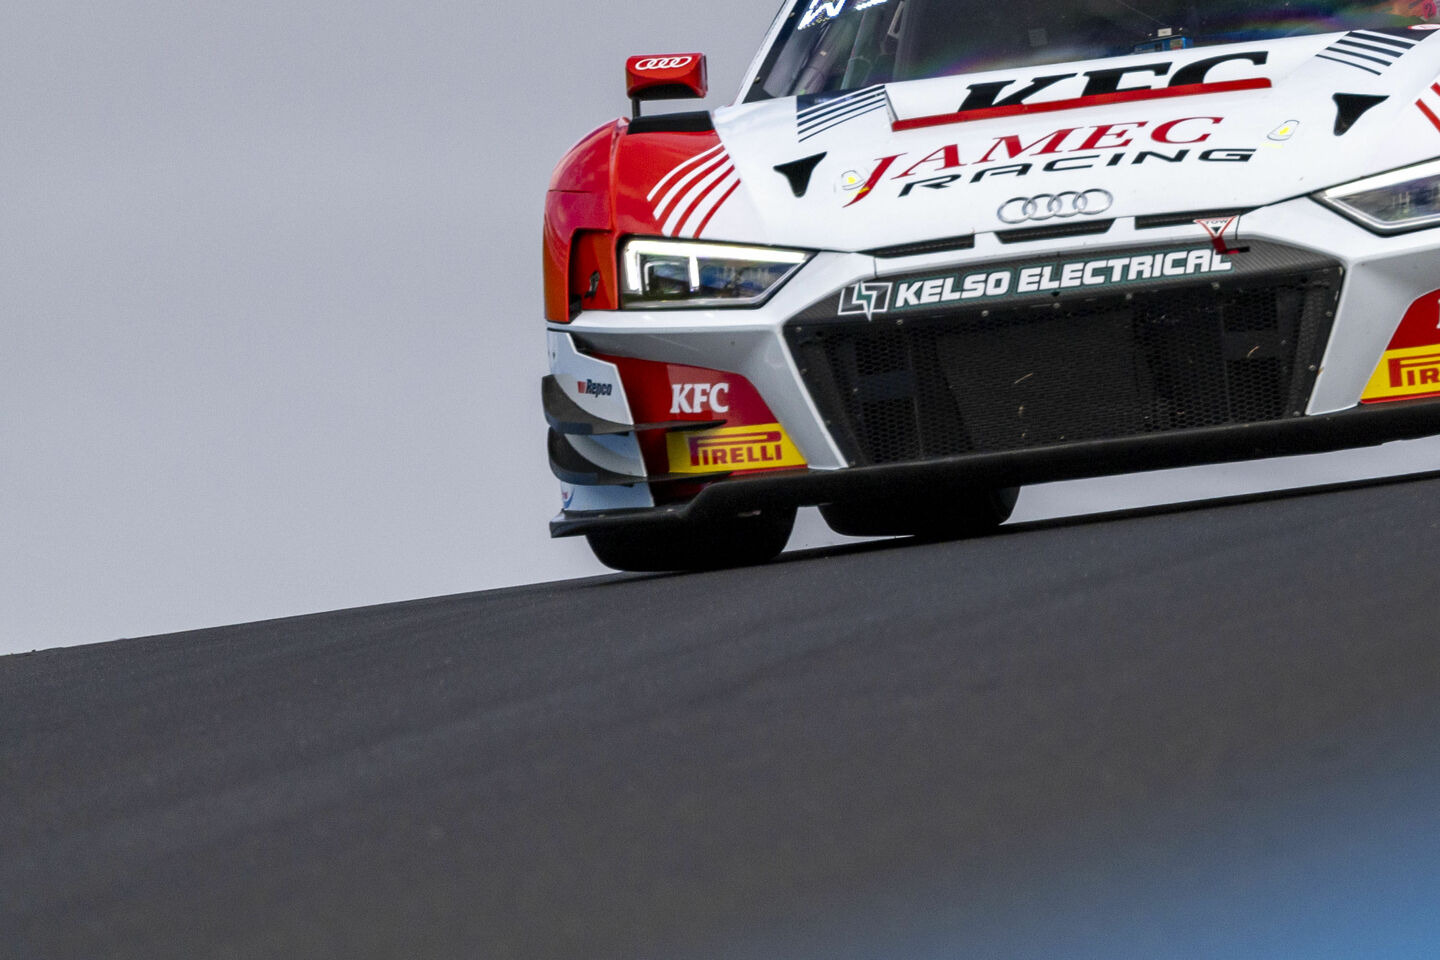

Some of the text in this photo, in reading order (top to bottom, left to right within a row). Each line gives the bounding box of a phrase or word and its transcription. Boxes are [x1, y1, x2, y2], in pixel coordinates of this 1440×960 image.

[842, 117, 1224, 208] JAMEC
[898, 148, 1257, 197] RACING
[895, 248, 1232, 308] KELSO ELECTRICAL
[586, 379, 613, 398] Repco
[668, 382, 730, 414] KFC
[688, 429, 783, 466] PIRELLI
